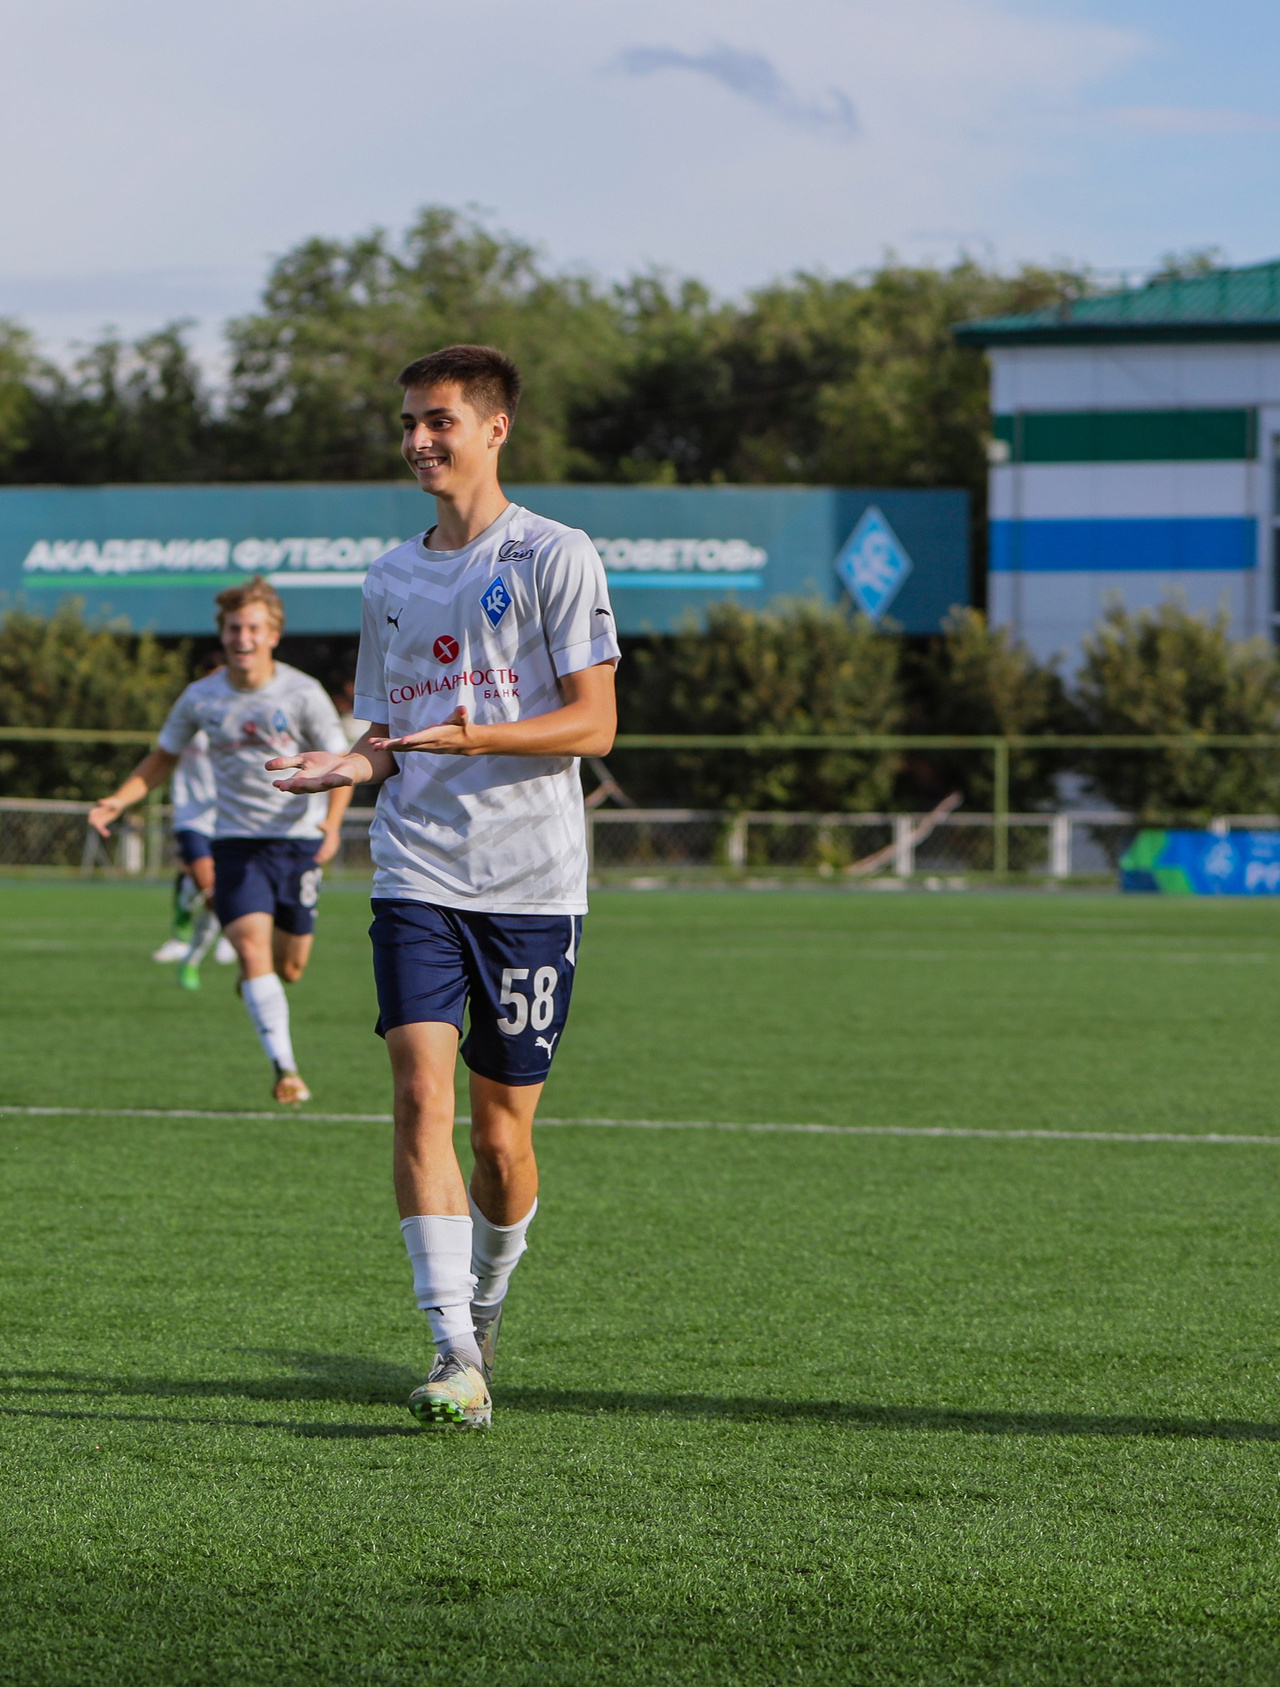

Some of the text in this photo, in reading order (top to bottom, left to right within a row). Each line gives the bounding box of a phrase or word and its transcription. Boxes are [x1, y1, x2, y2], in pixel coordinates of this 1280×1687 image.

[23, 538, 230, 576] АКАДЕМИЯ
[484, 688, 520, 698] БАНК
[497, 966, 558, 1035] 58
